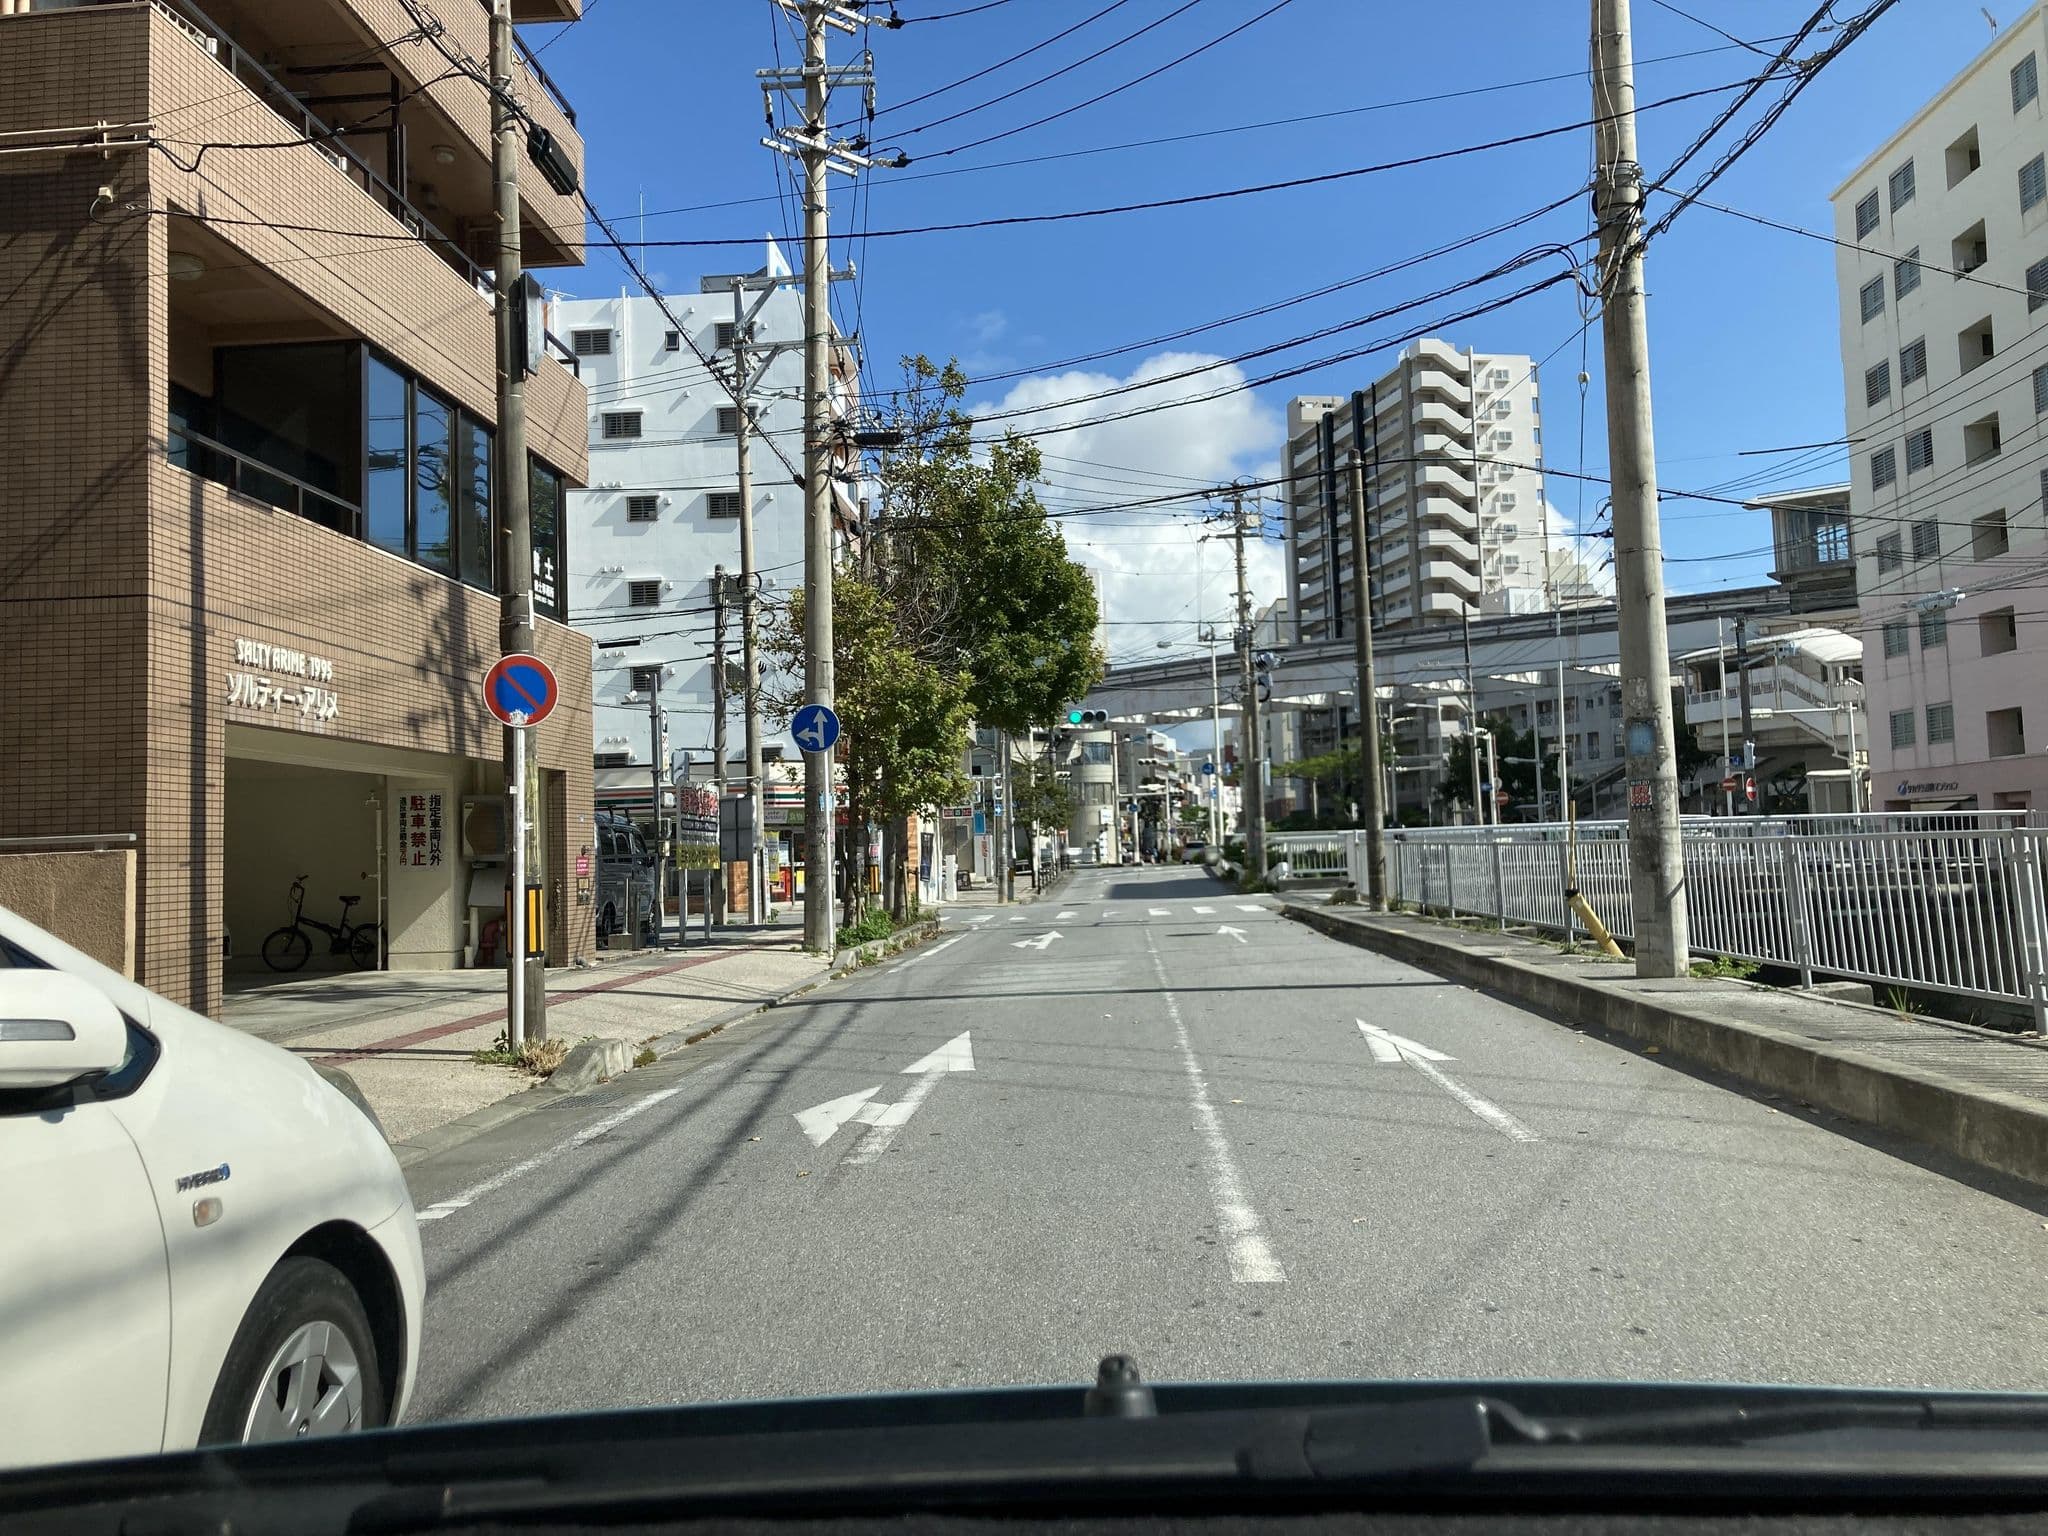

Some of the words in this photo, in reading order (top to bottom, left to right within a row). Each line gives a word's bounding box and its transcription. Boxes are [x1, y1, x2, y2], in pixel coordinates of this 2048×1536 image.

[235, 639, 271, 669] SALTY
[271, 647, 306, 675] ARIME
[307, 656, 333, 681] 1995
[410, 795, 427, 867] 駐車禁止
[429, 794, 441, 866] 指定車両以外
[176, 1167, 222, 1193] HYBRID
